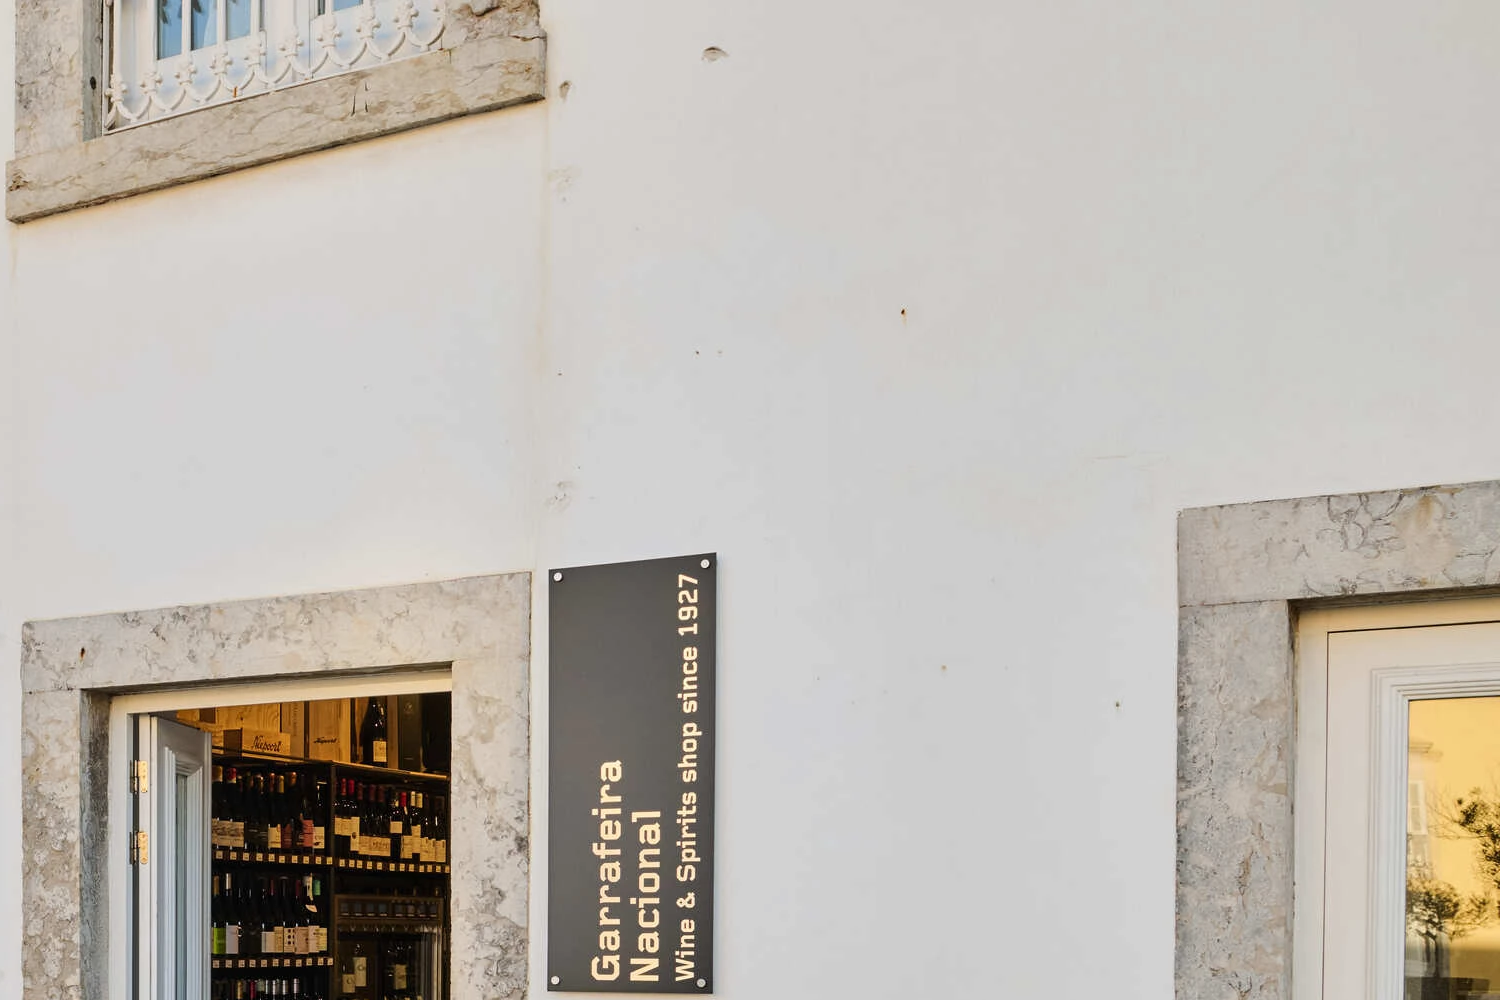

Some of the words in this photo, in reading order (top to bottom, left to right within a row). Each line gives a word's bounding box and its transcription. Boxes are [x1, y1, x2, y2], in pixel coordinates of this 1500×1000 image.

[677, 573, 698, 637] 1927
[677, 646, 698, 714] since
[677, 722, 703, 783] shop
[675, 791, 701, 882] Spirits
[591, 759, 623, 982] Garrafeira
[629, 810, 661, 982] Nacional
[675, 891, 696, 909] &
[674, 918, 696, 982] Wine
